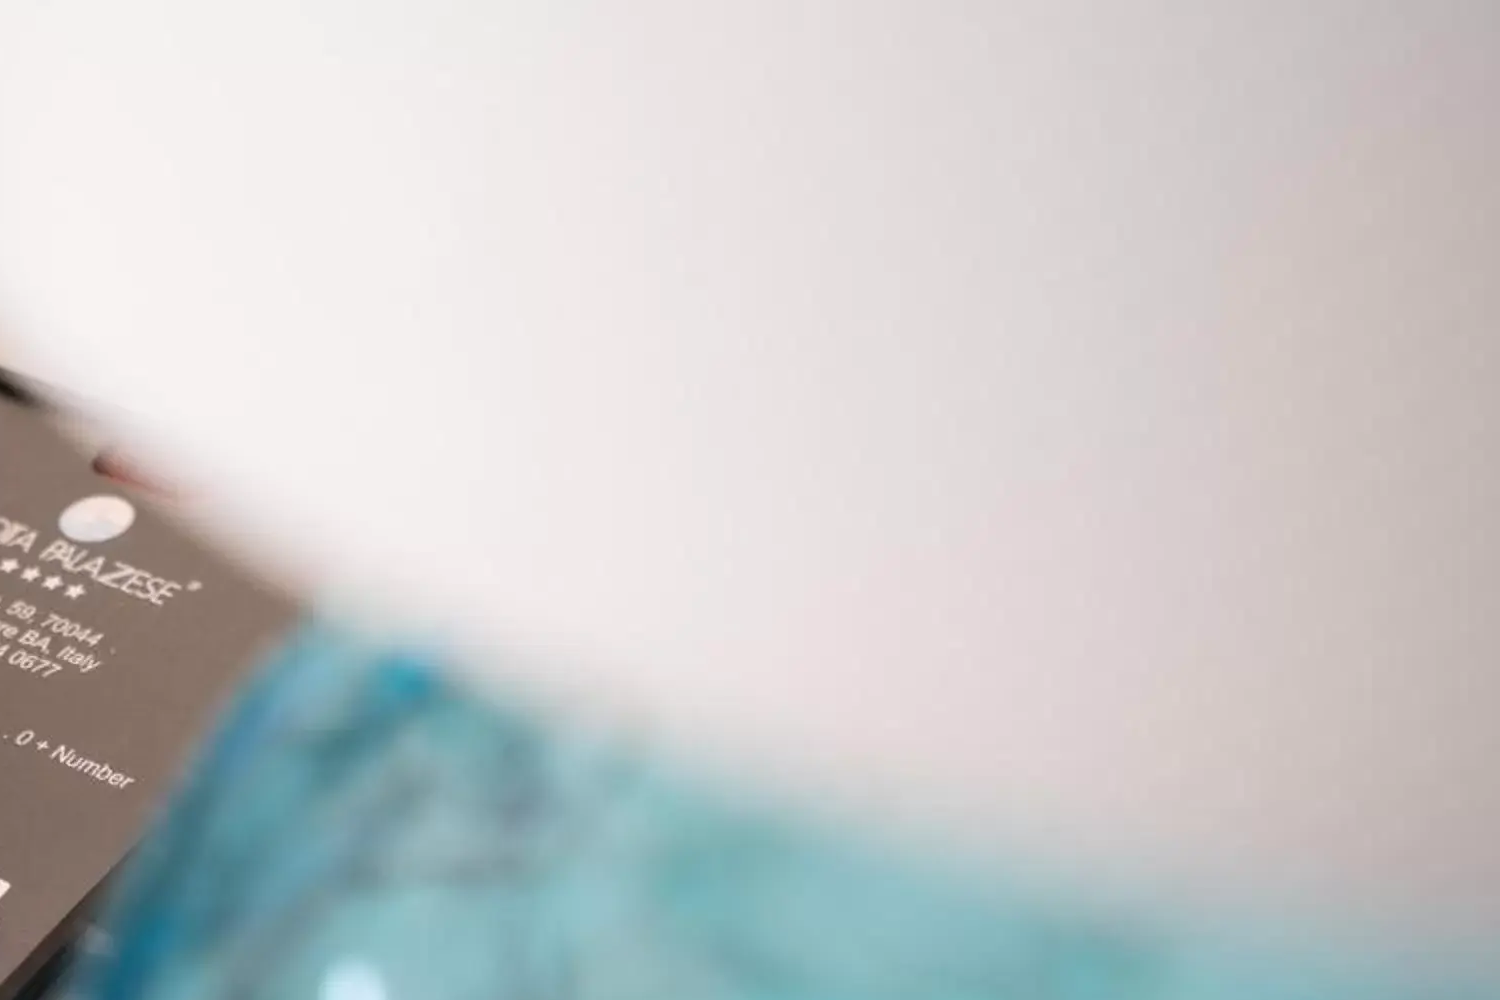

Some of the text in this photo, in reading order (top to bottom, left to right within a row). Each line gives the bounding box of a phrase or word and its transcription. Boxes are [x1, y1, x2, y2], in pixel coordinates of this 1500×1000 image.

[41, 613, 104, 647] 70044
[6, 649, 63, 679] 0677
[55, 646, 102, 673] Italy
[48, 743, 136, 791] Number
